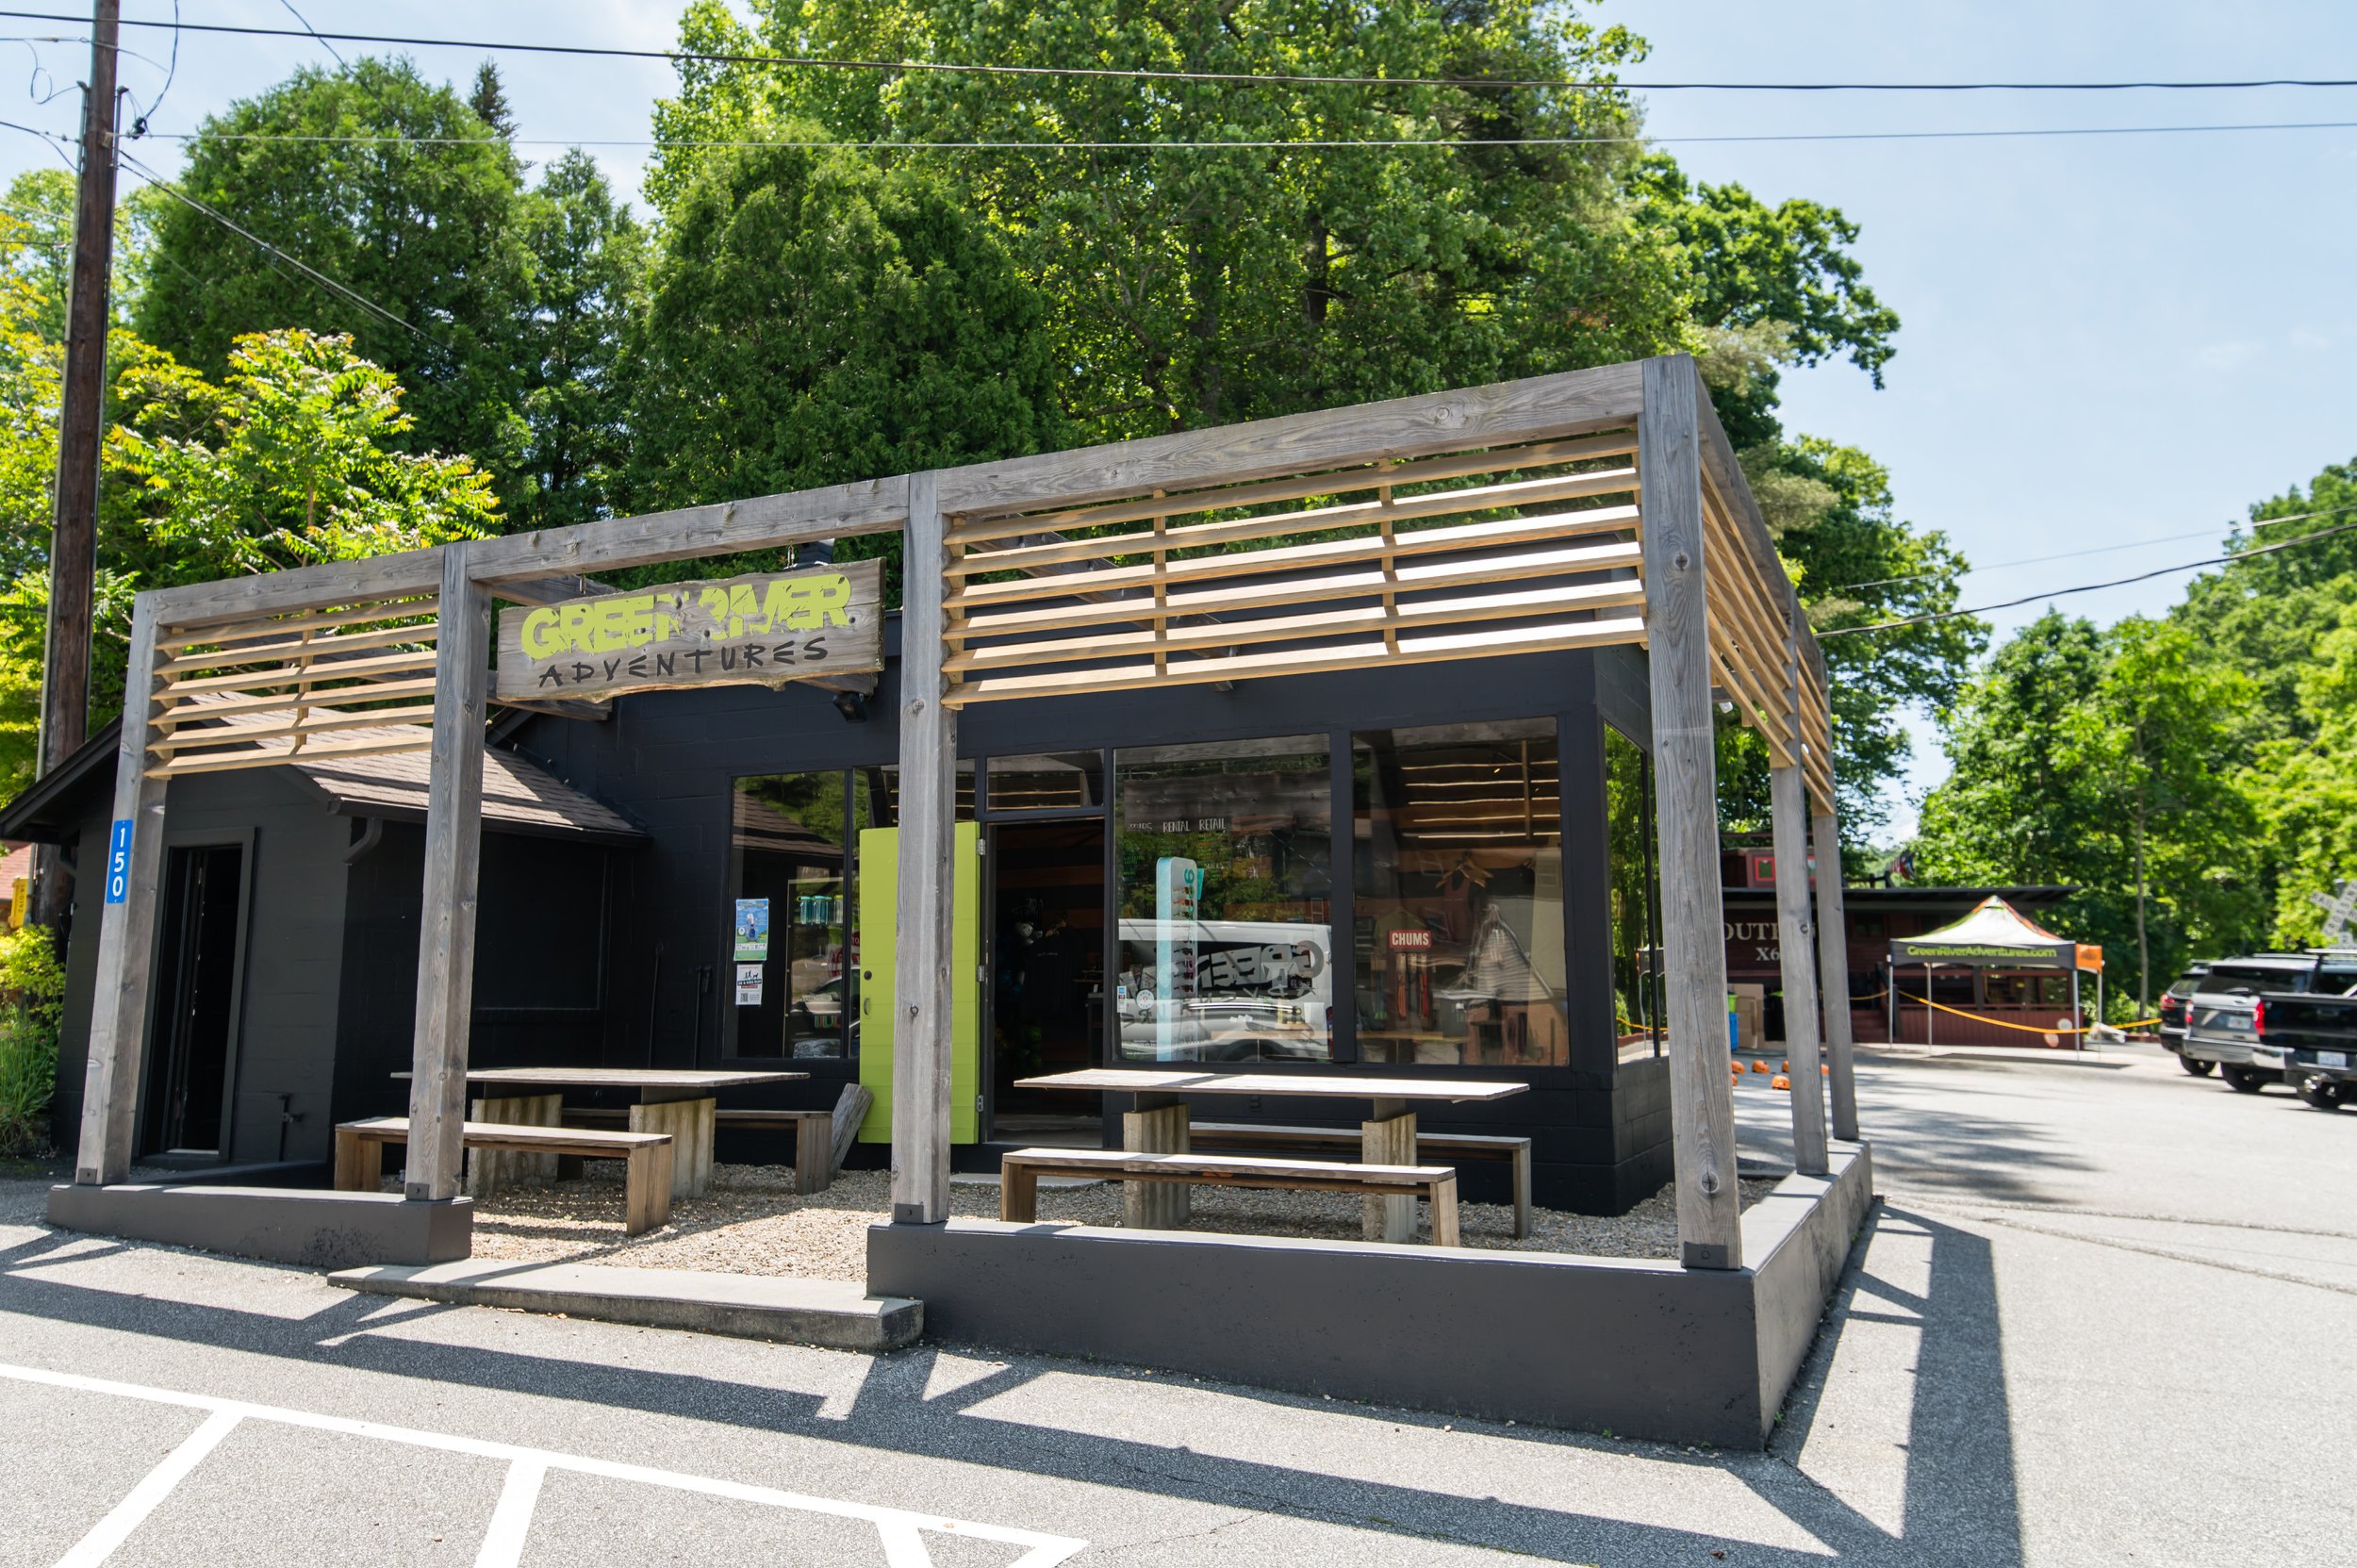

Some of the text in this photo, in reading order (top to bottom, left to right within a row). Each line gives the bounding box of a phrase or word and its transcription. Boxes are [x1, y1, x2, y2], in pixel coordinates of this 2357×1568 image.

[521, 592, 689, 660] GREEN
[539, 636, 828, 687] ADVENTURES
[1162, 820, 1191, 833] RENTAL
[1198, 817, 1227, 831] RETAIL
[111, 827, 125, 897] 150
[1391, 932, 1430, 946] CHUMS
[1906, 945, 2058, 958] GreenRiverAdventures.com
